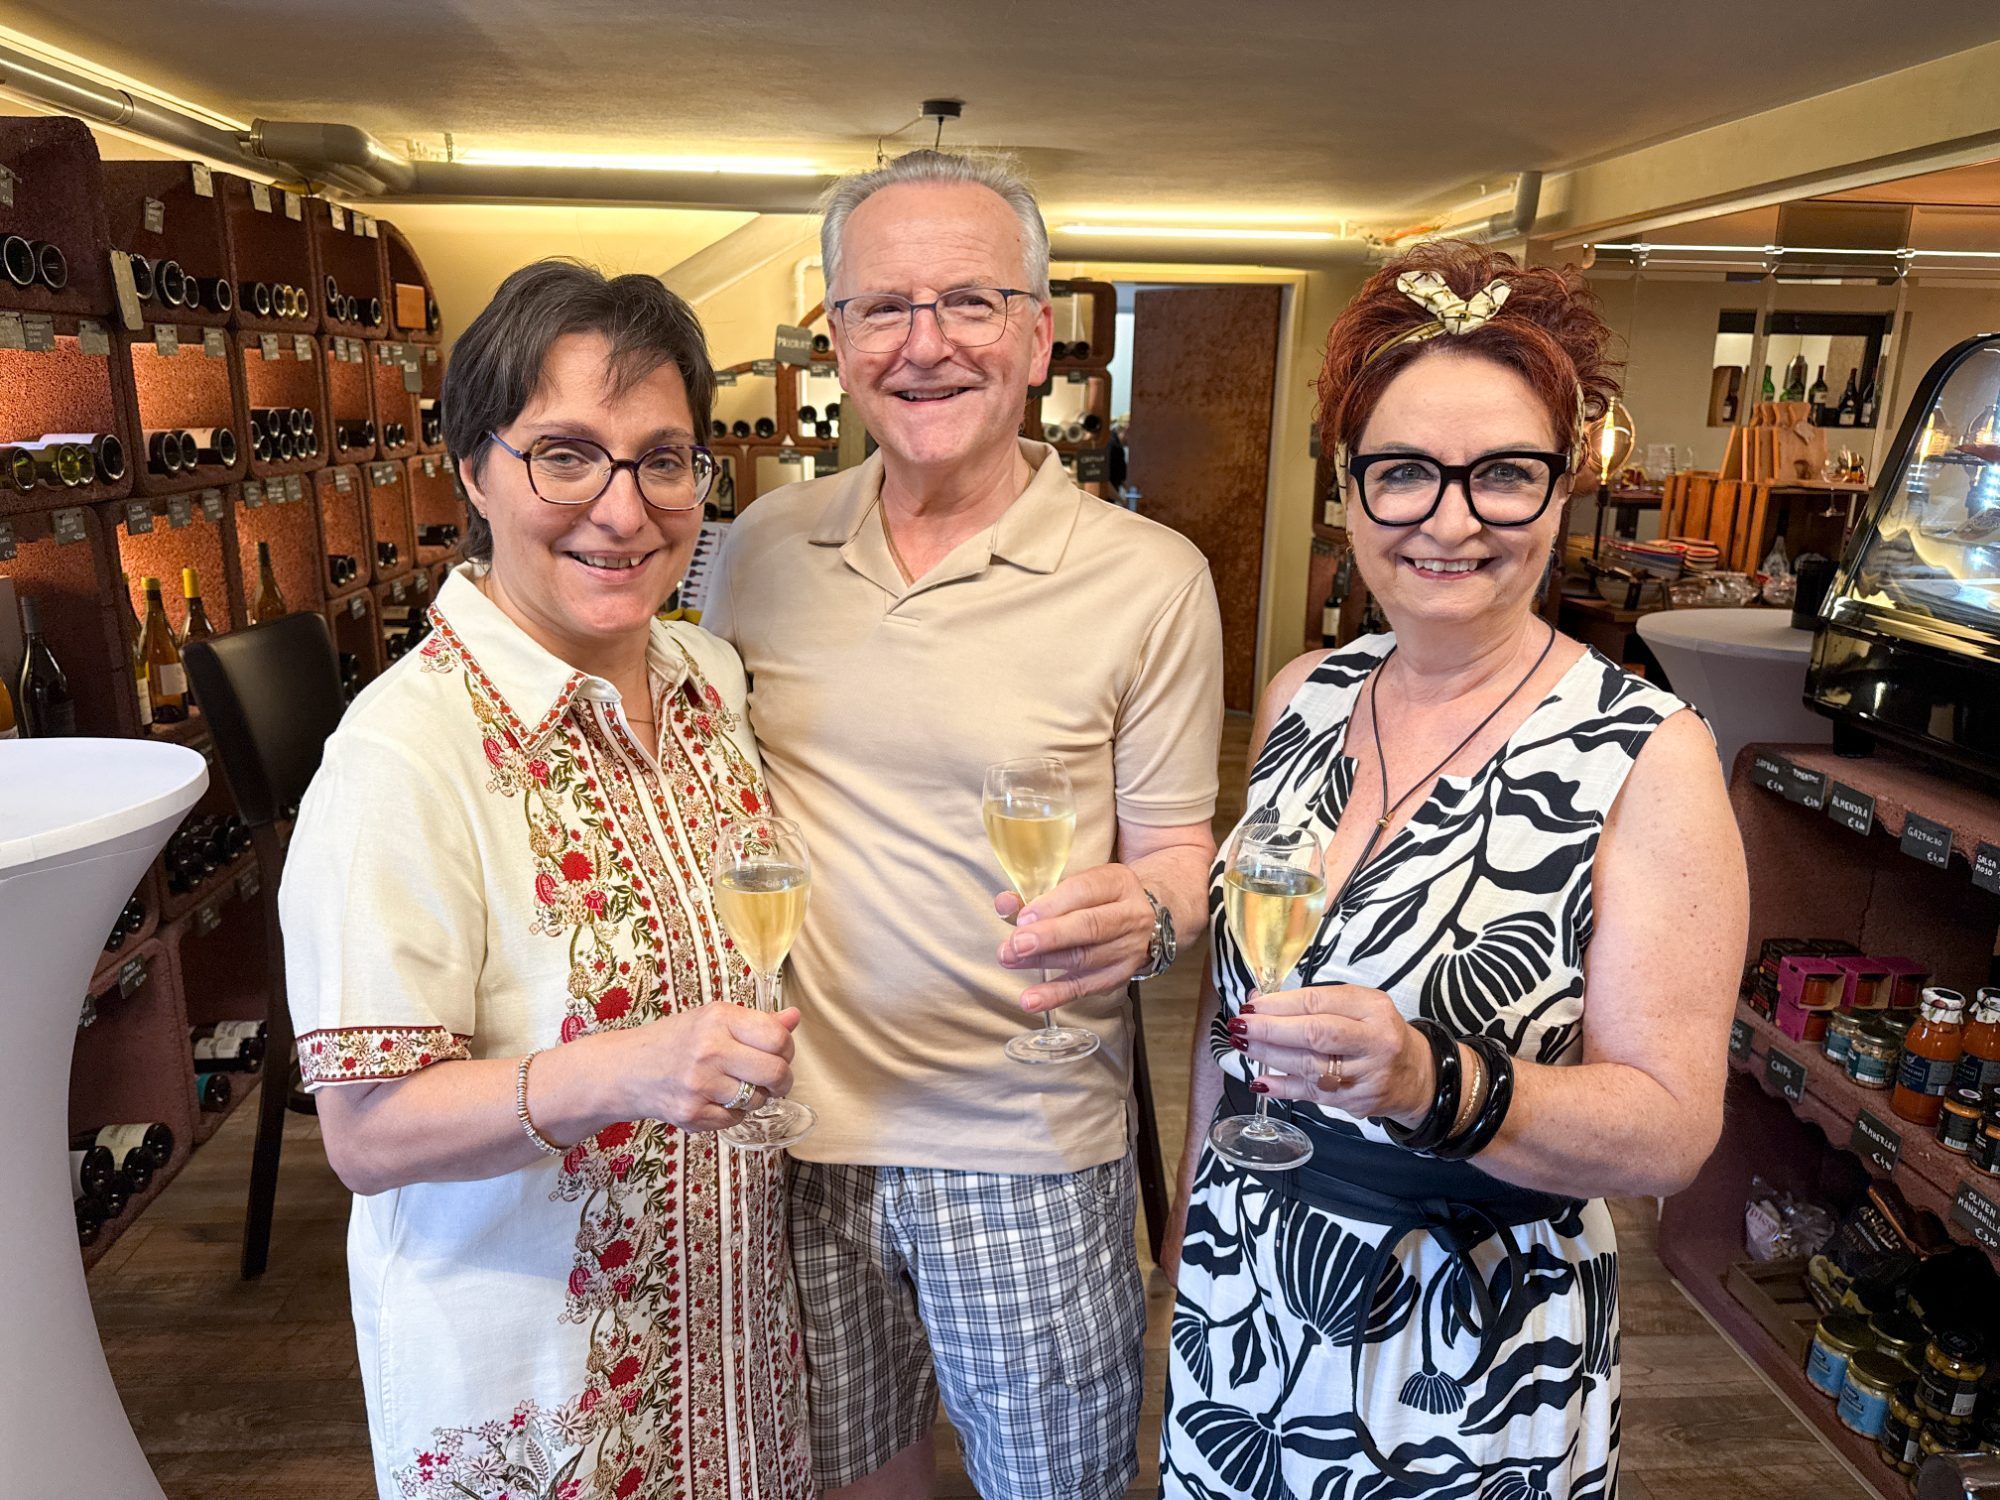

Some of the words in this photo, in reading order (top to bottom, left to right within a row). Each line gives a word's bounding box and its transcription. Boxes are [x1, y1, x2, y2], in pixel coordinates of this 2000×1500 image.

[1832, 795, 1868, 818] ALMENDRA
[1975, 863, 1993, 876] MOJO
[1977, 855, 1997, 868] SALSA
[1968, 1191, 1997, 1218] OLIVEN
